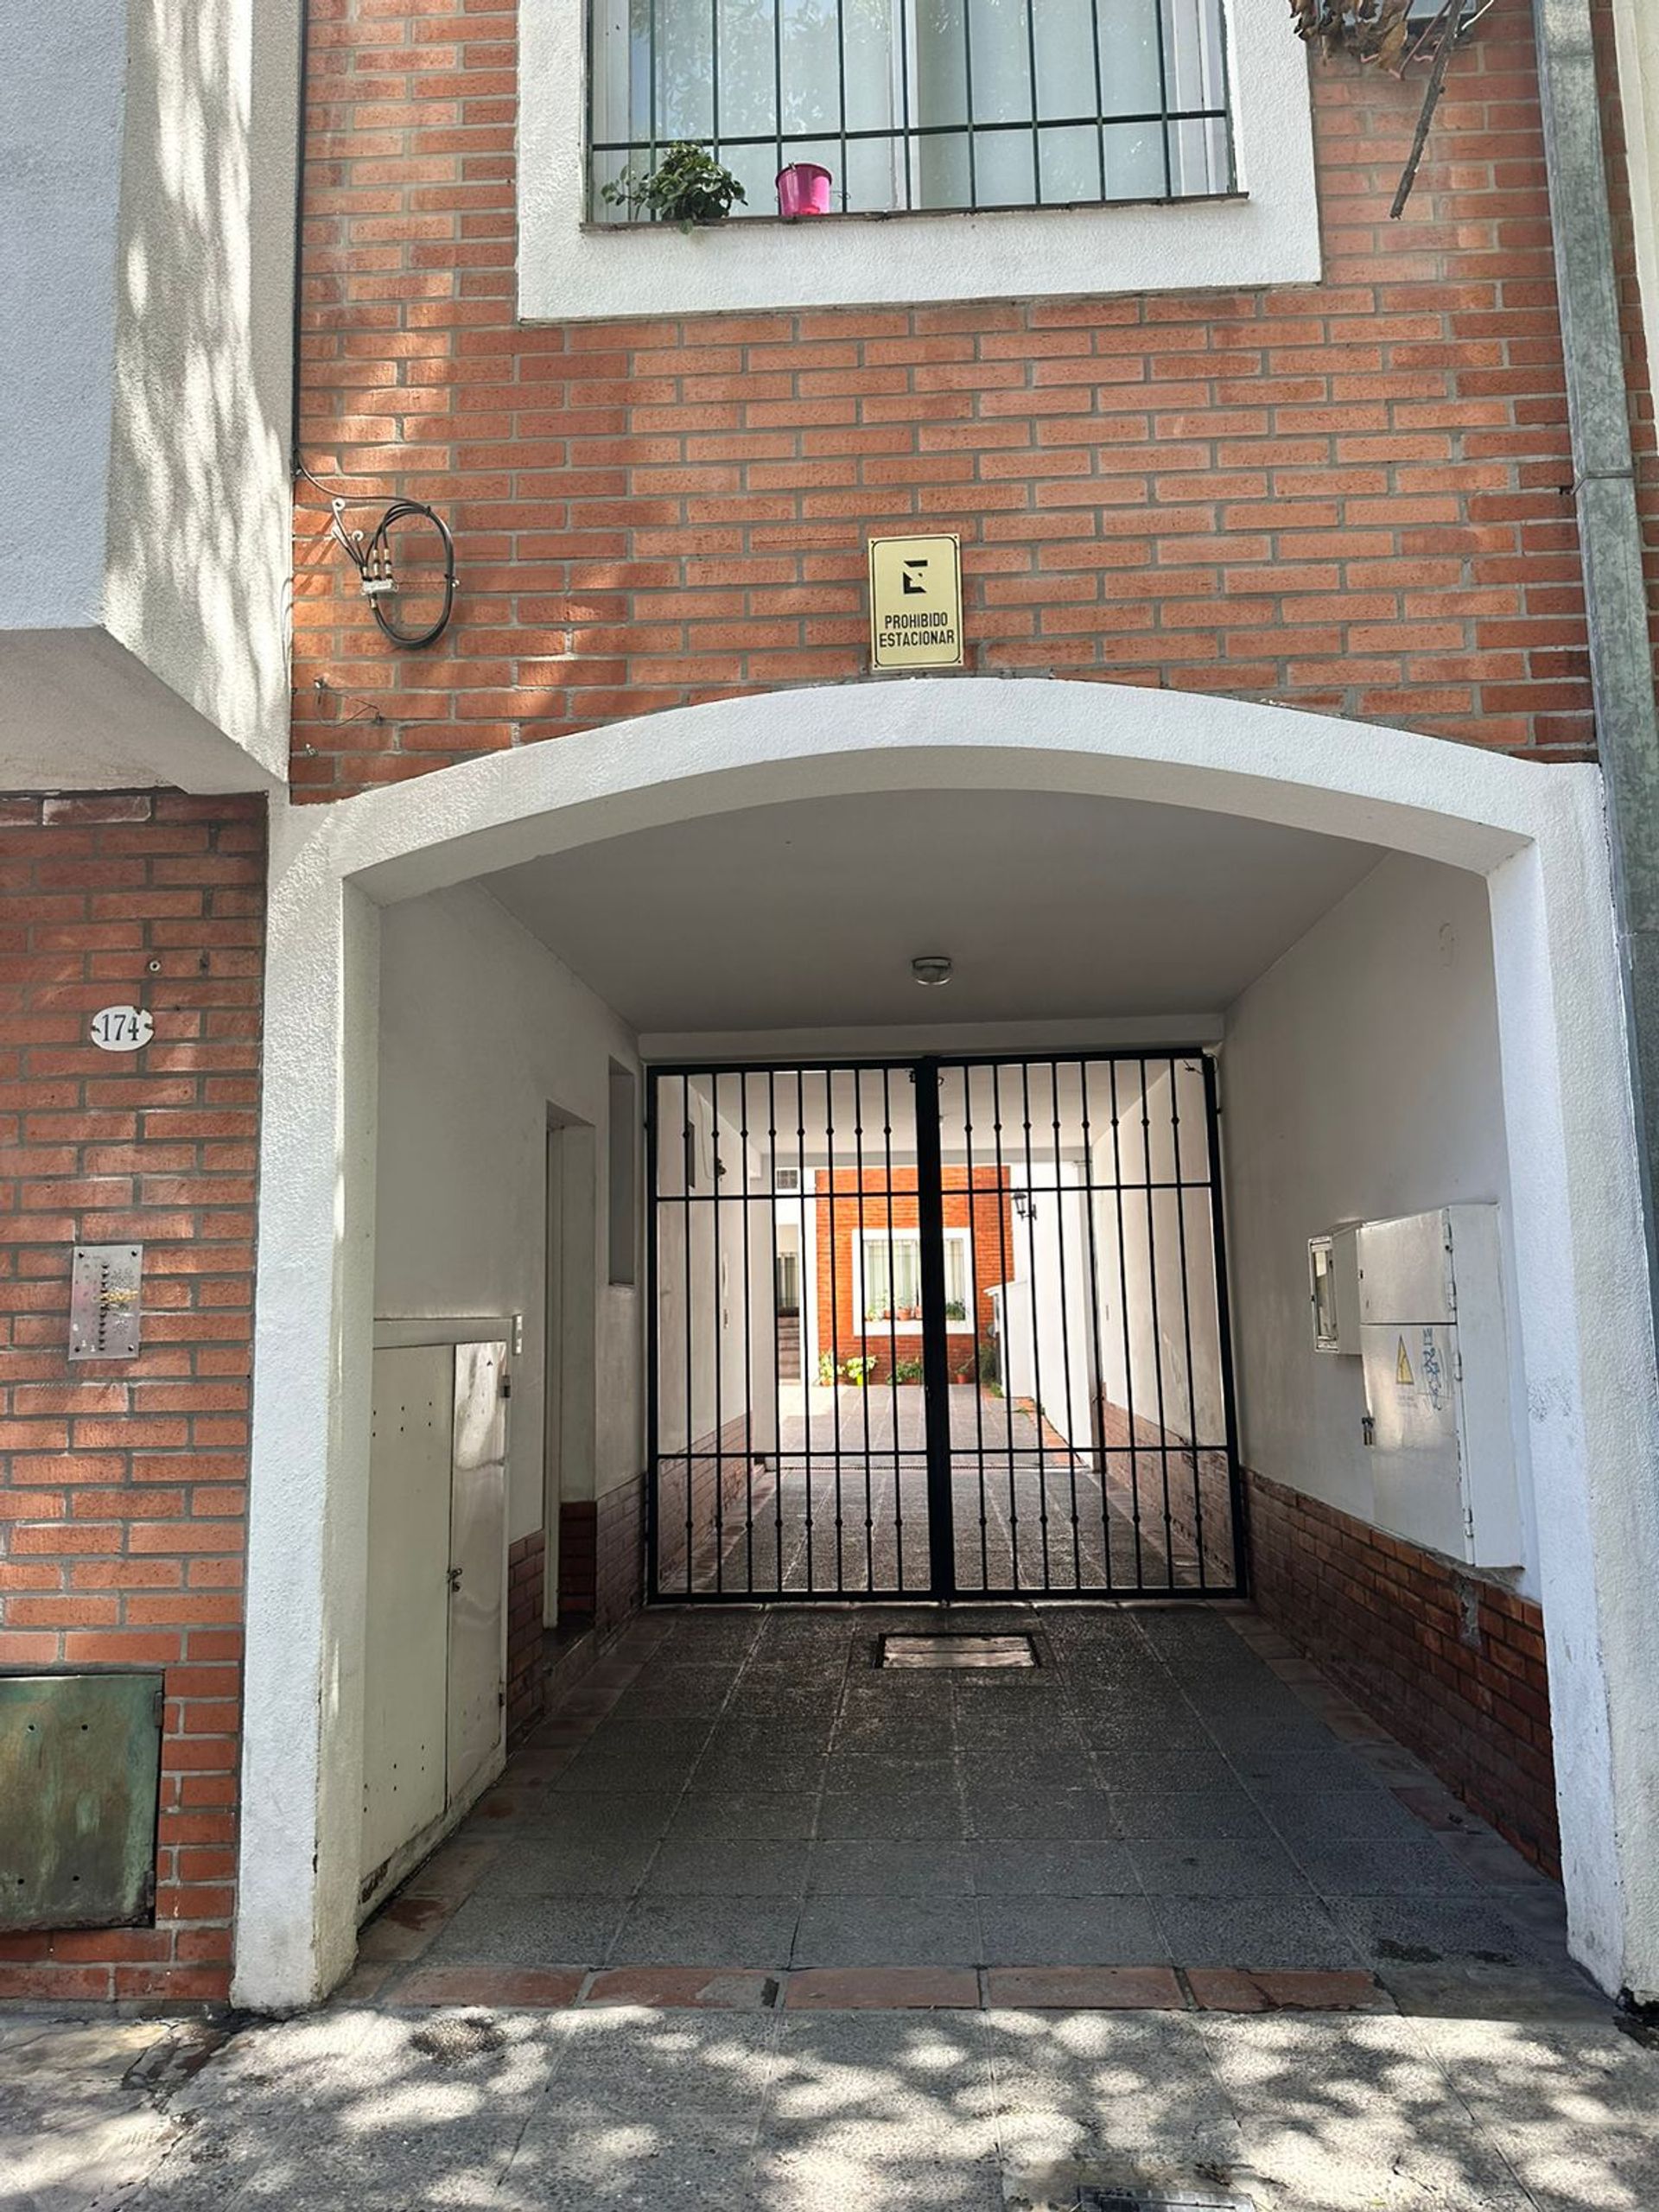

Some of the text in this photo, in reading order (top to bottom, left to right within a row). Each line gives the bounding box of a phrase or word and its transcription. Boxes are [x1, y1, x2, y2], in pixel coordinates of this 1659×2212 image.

[884, 612, 949, 630] PROHIBIDO
[879, 629, 955, 648] ESTACIONAR
[102, 1014, 140, 1042] 174
